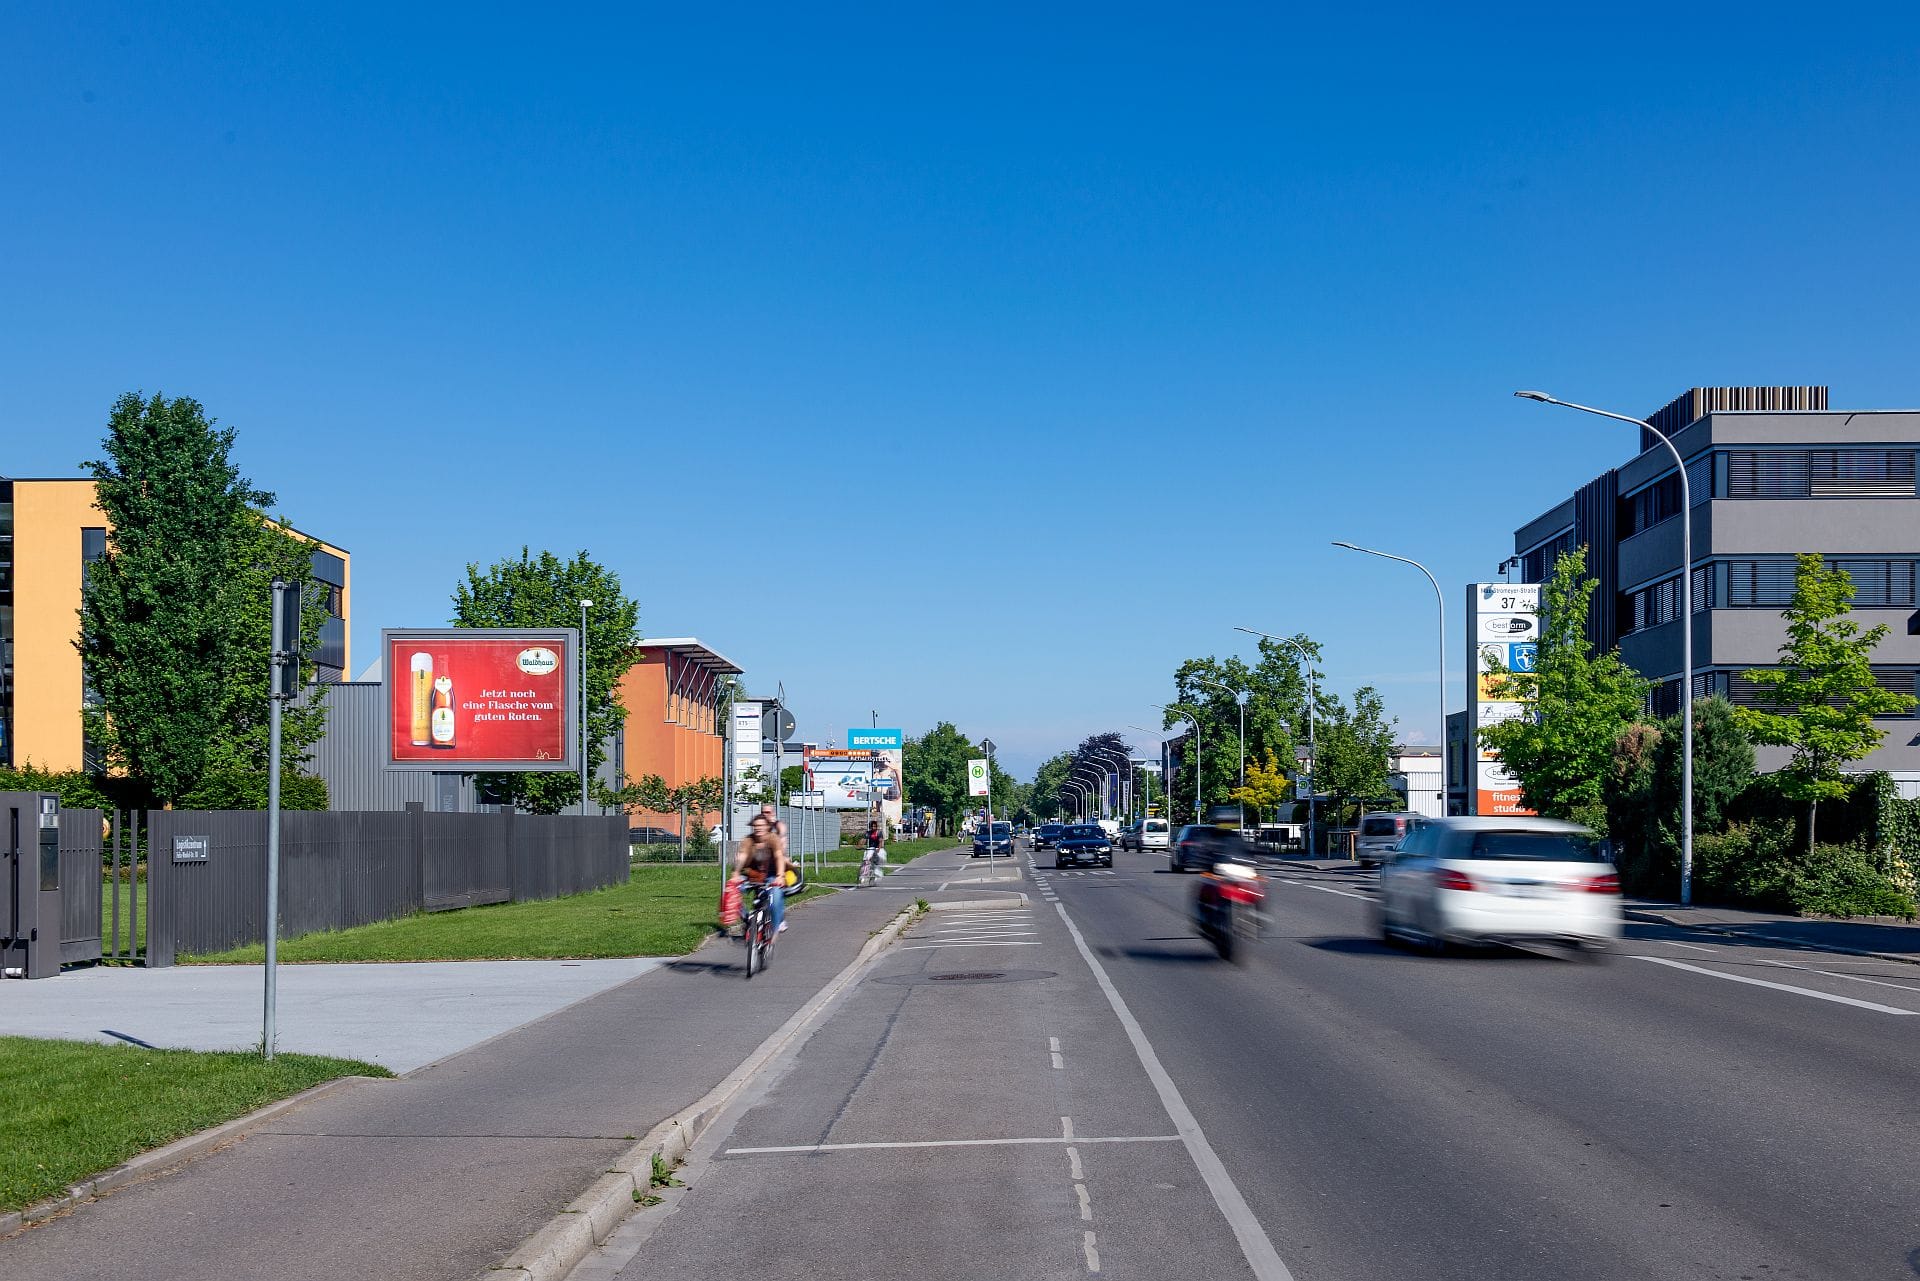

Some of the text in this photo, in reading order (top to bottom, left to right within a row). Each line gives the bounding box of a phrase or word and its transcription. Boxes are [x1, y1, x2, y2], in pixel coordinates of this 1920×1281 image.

[1501, 597, 1516, 609] 37
[522, 658, 554, 667] Waldhaus
[480, 689, 536, 698] Jetzt noch
[463, 700, 554, 710] eine Flasche vom
[474, 712, 542, 723] guten Roten.
[853, 736, 897, 745] BERTSCHE
[974, 768, 981, 776] H
